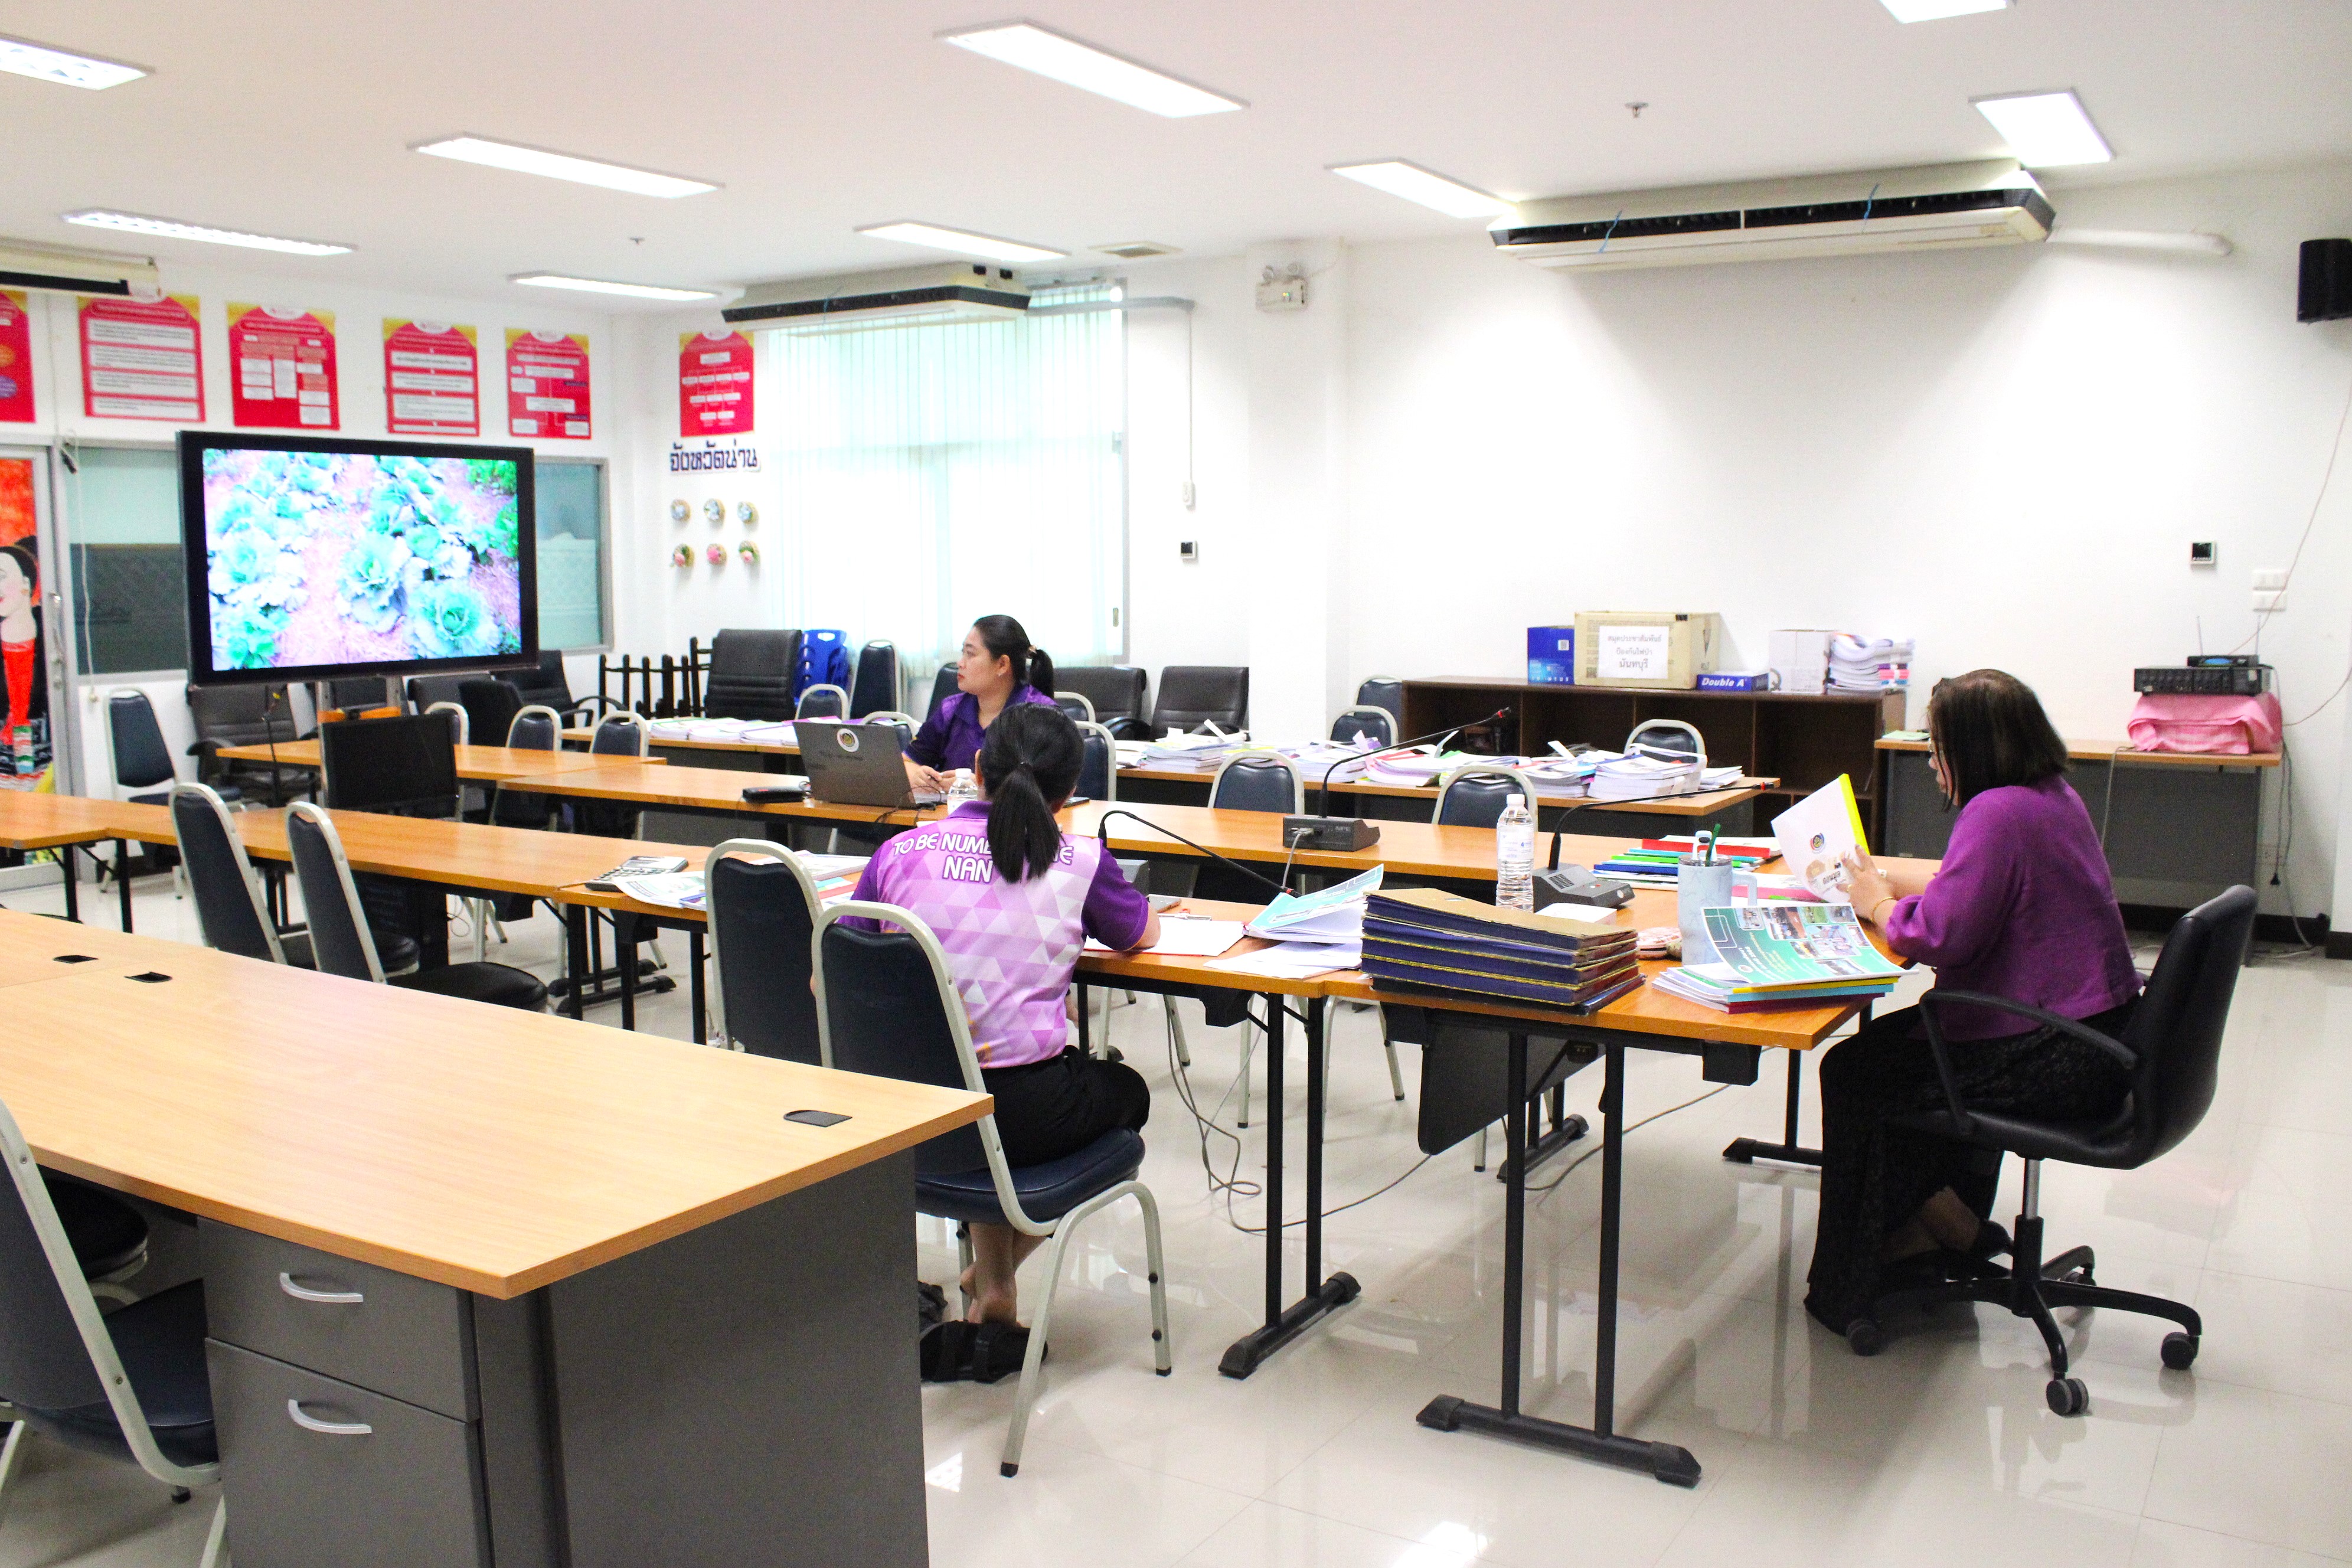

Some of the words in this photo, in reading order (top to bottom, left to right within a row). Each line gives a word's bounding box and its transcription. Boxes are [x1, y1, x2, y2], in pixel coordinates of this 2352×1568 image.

[670, 438, 757, 471] จังหวัดน่าน
[1701, 677, 1735, 687] Double
[894, 838, 914, 856] TO
[914, 833, 939, 850] BE
[940, 832, 992, 855] NUM
[943, 855, 993, 883] NAN
